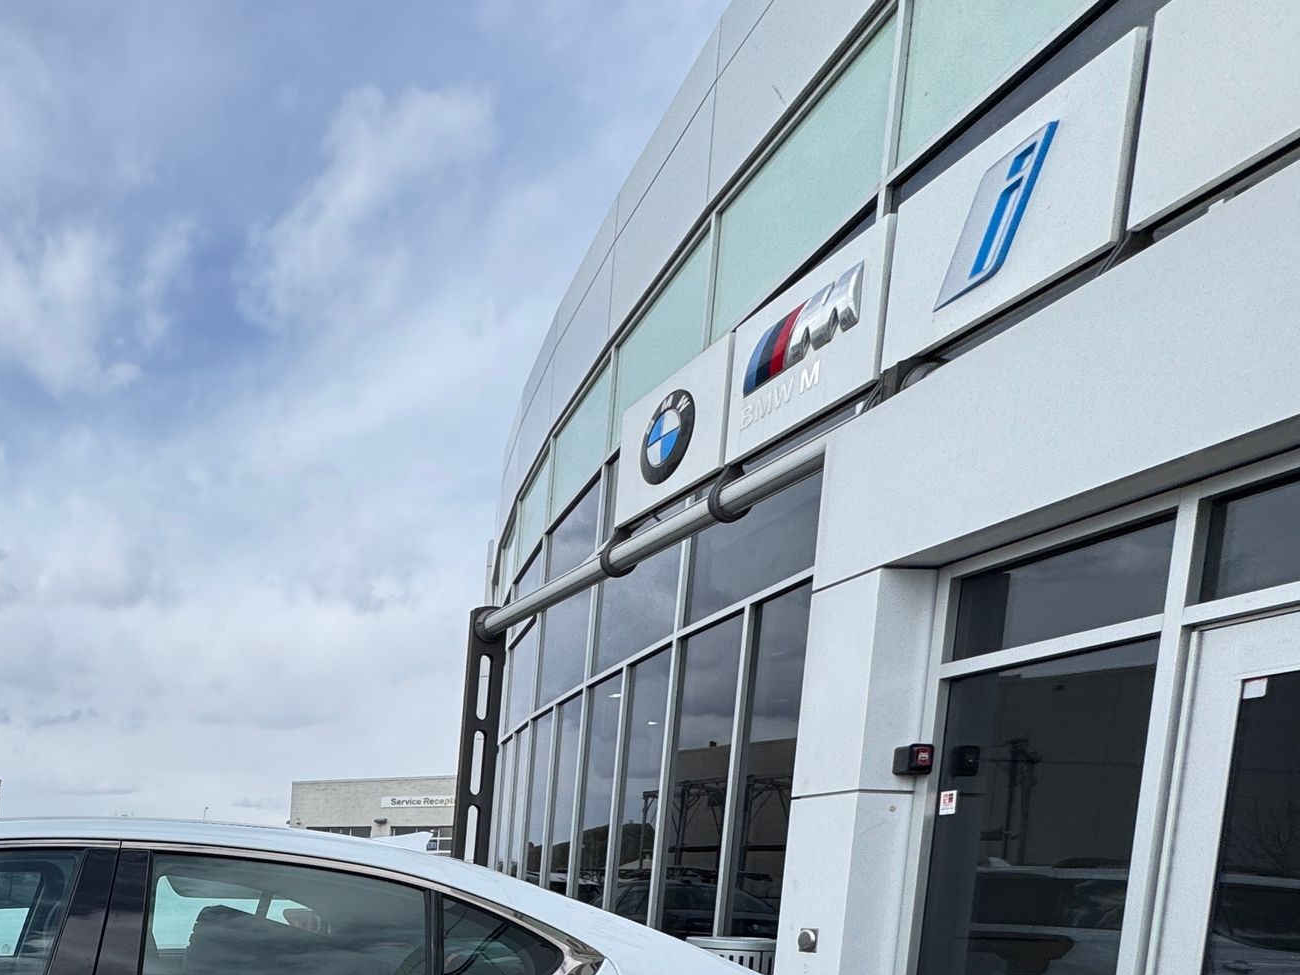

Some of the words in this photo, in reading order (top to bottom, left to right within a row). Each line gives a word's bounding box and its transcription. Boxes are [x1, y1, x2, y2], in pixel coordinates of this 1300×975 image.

[740, 376, 796, 431] BMW
[799, 359, 821, 395] M
[390, 797, 422, 806] Service
[423, 797, 454, 806] Recept
